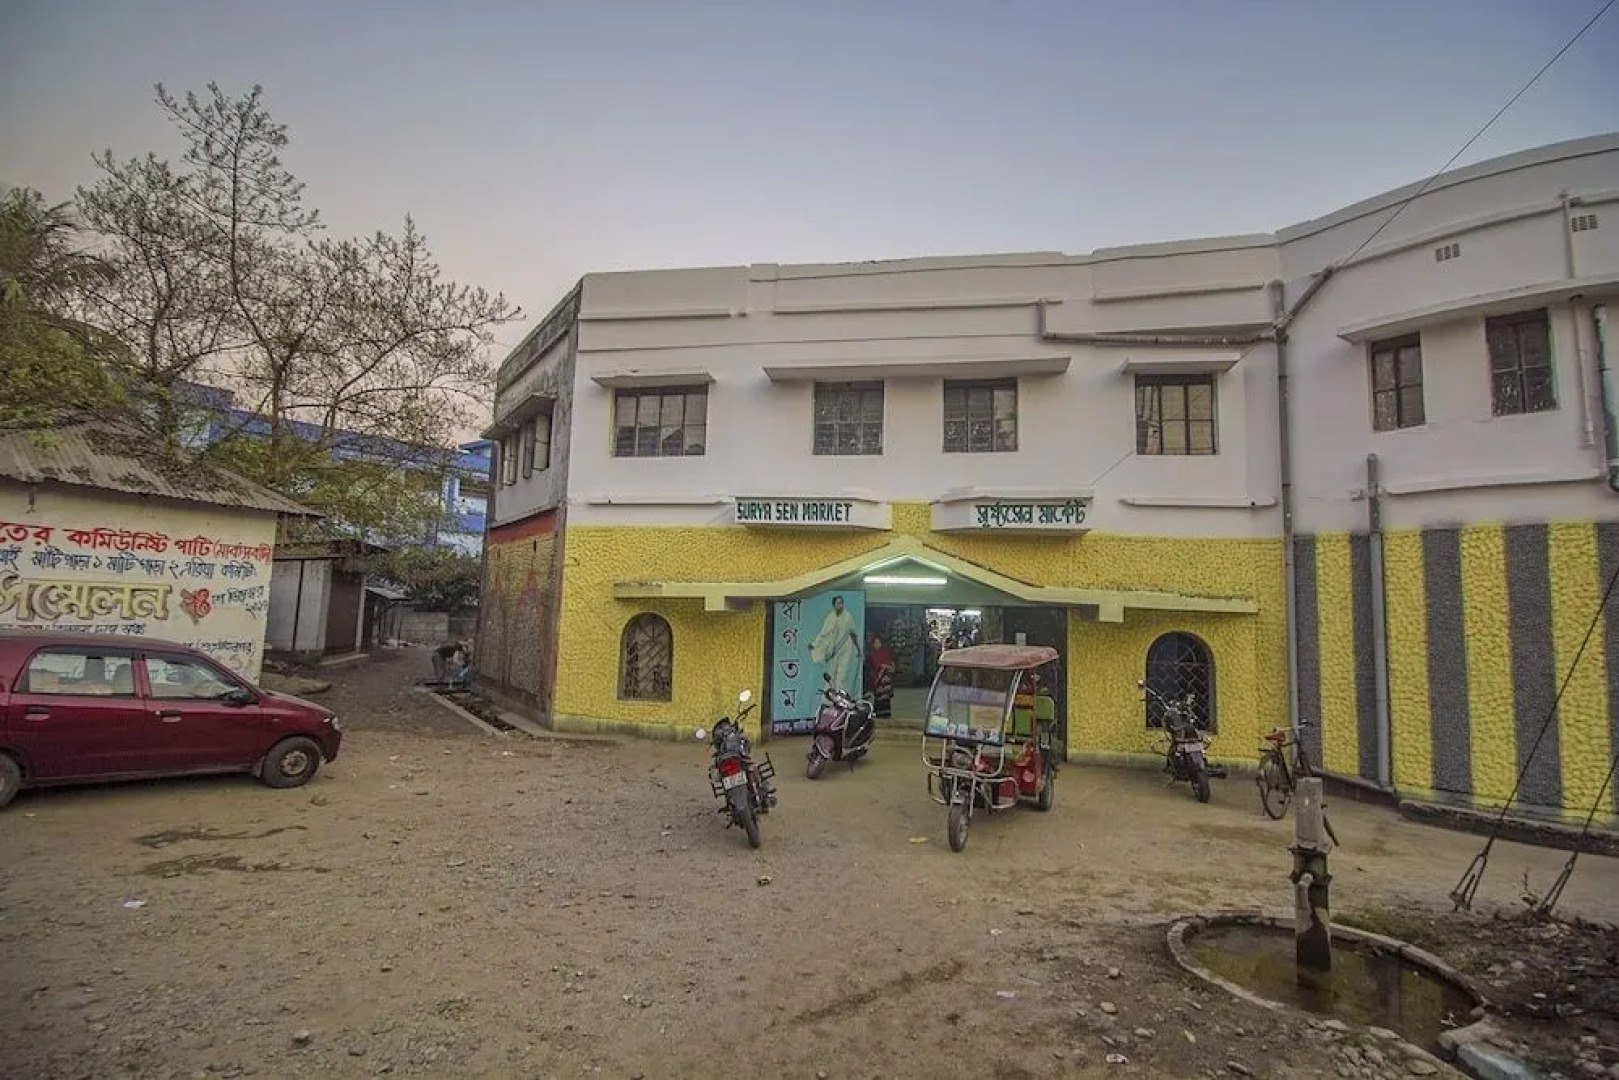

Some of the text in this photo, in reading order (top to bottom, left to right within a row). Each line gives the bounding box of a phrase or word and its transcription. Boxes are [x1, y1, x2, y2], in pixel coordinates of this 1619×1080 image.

[736, 502, 853, 522] SURYA SEN MARKET
